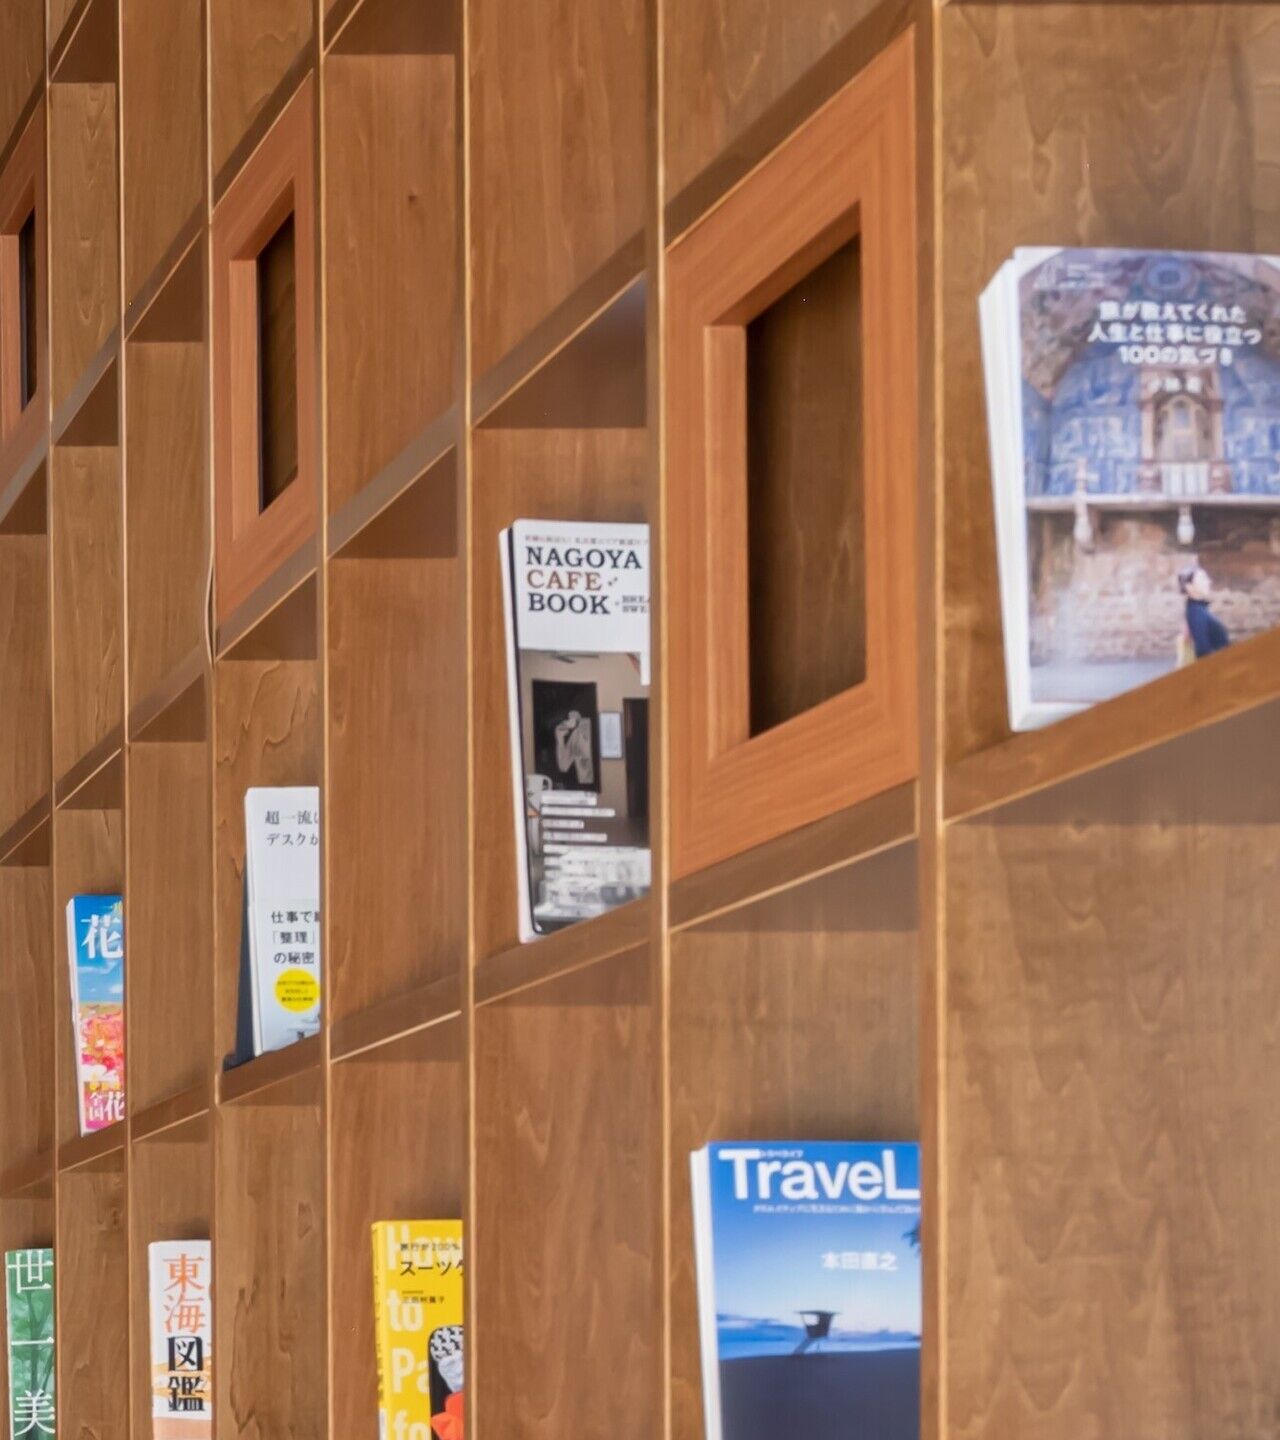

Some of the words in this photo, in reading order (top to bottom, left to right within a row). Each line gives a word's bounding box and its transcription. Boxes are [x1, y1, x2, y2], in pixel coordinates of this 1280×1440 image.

[526, 546, 643, 569] NAGOYA
[527, 570, 602, 591] CAFE
[528, 592, 611, 615] BOOK
[271, 910, 319, 924] 仕事で
[80, 914, 124, 959] 花
[273, 952, 315, 965] の秘密
[390, 1289, 423, 1331] to
[162, 1253, 206, 1412] 東海図鑑
